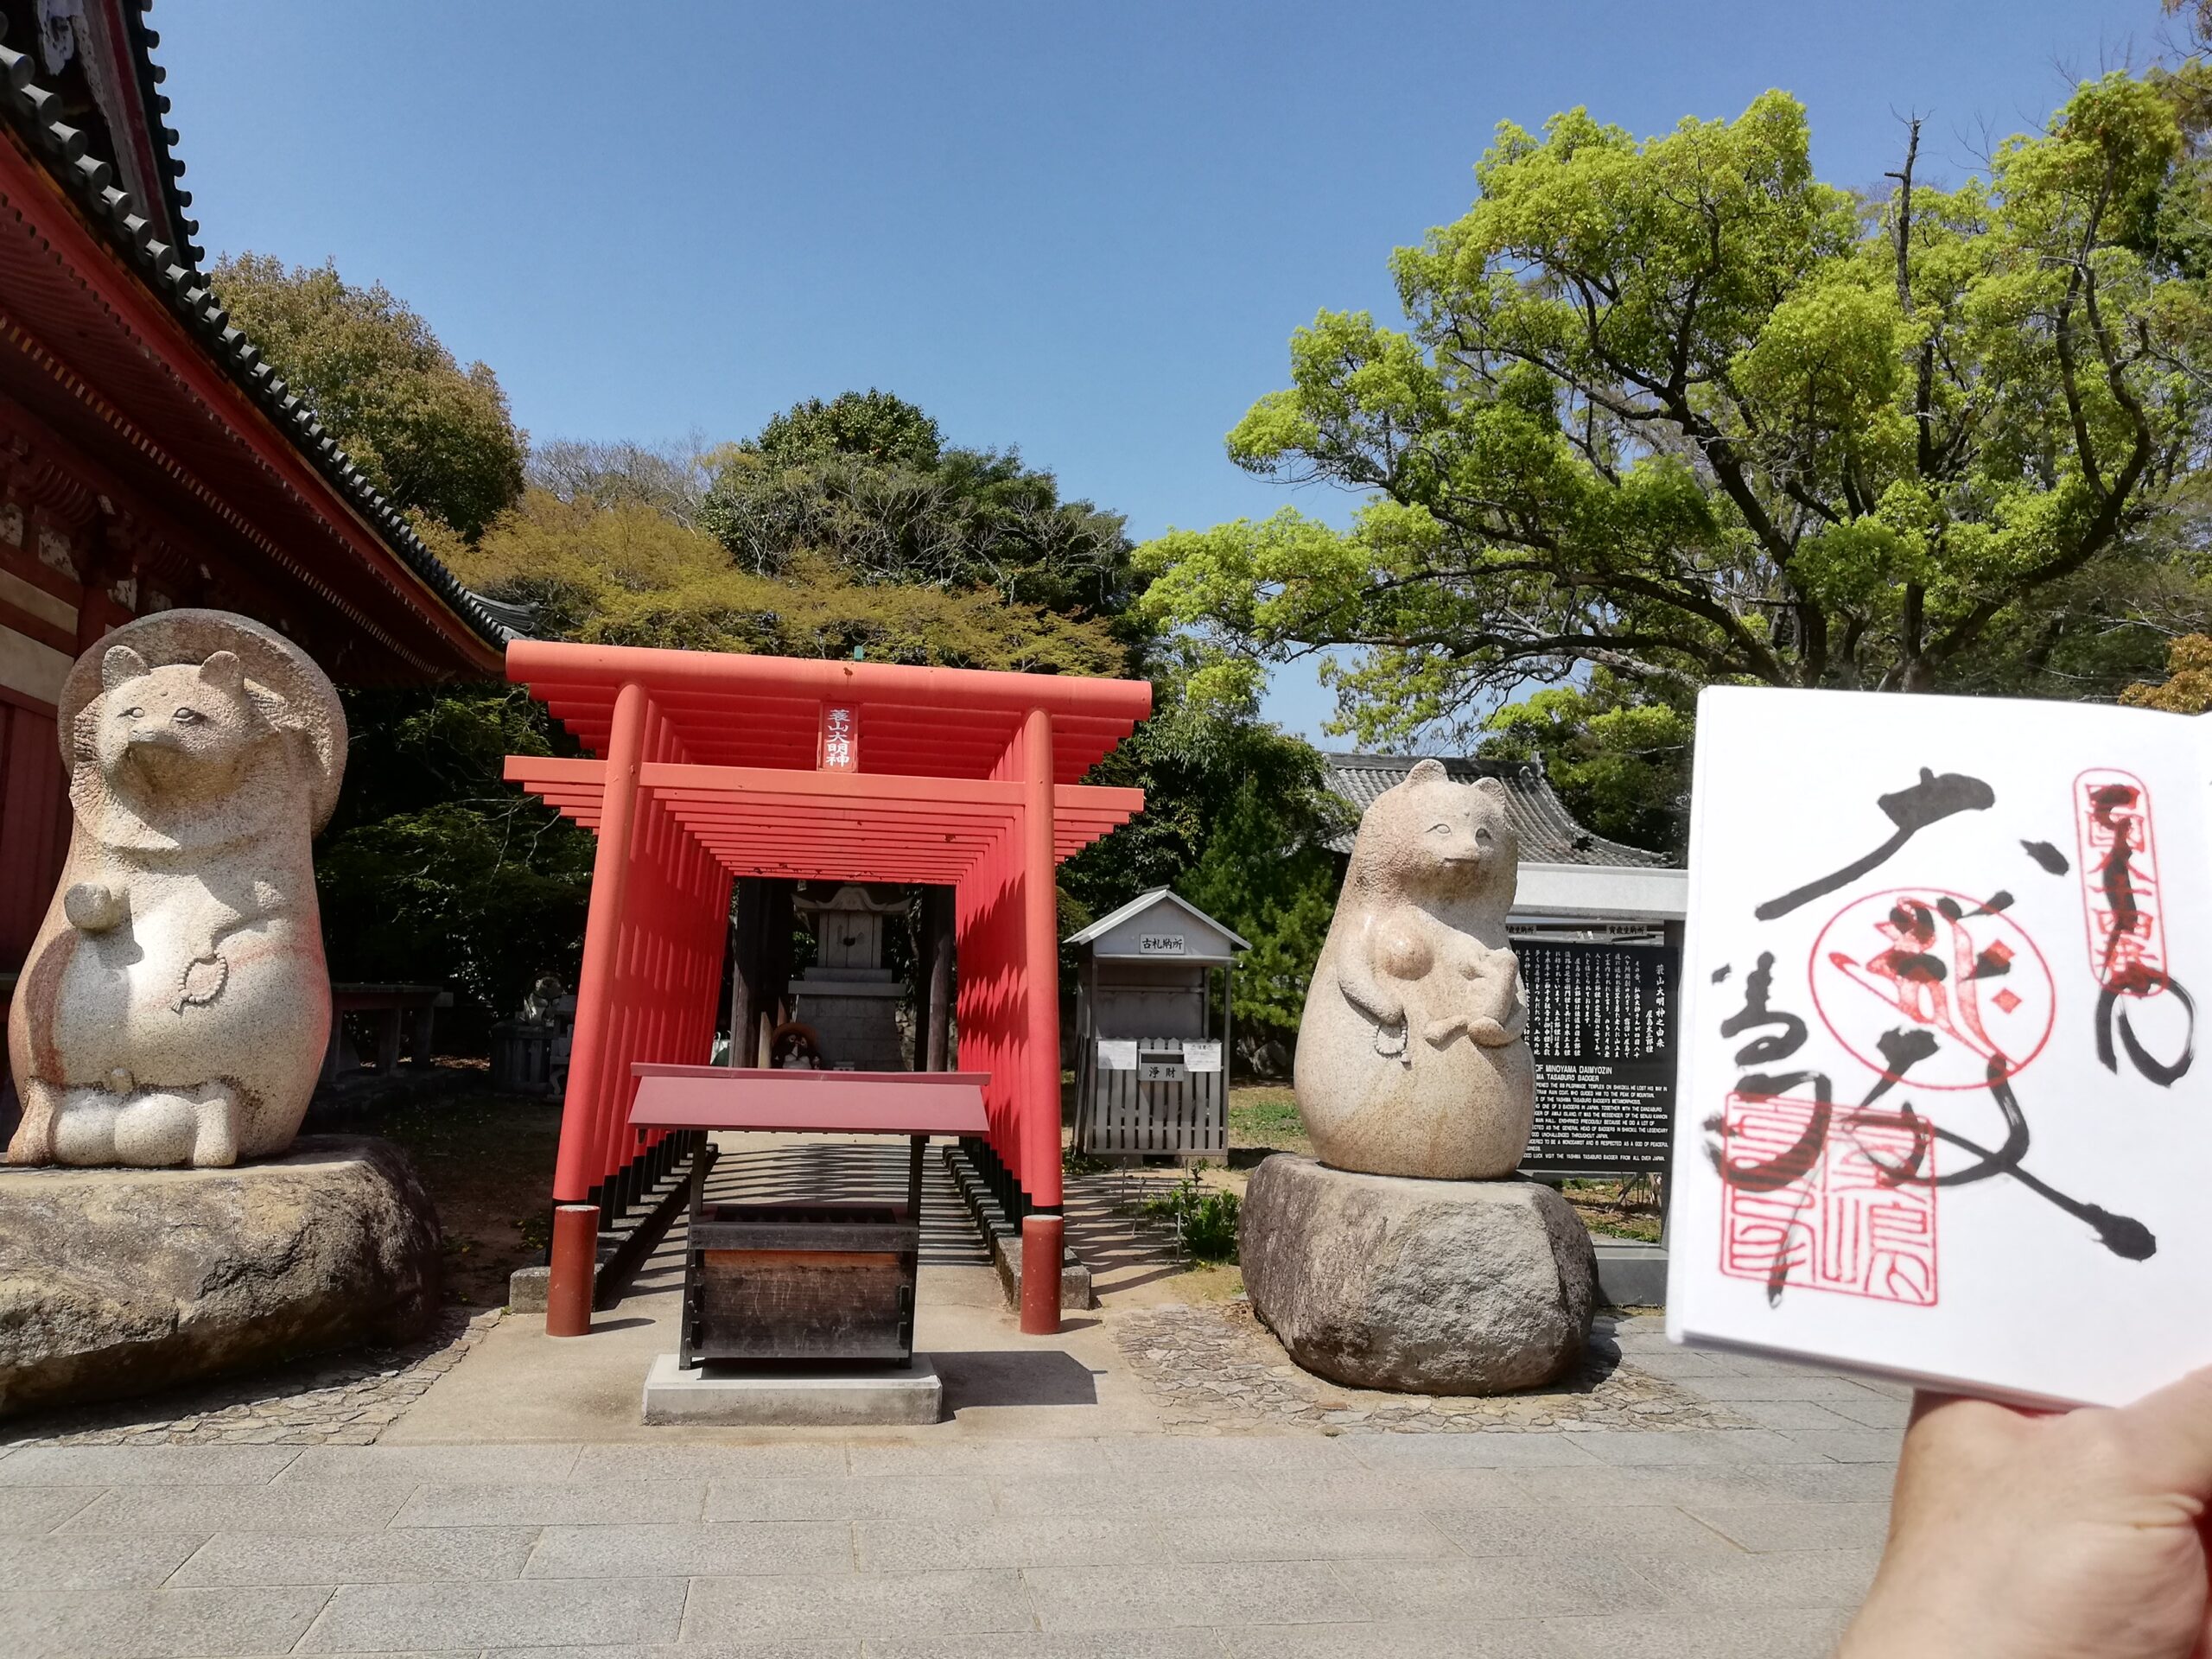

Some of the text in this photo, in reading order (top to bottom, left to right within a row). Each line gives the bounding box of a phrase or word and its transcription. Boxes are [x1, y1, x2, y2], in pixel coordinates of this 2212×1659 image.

[825, 709, 851, 768] 蓑山大明神
[1141, 938, 1183, 950] 古札納所
[1546, 1065, 1577, 1073] MINOYAMA
[1580, 1065, 1612, 1075] DAIMYOZIN
